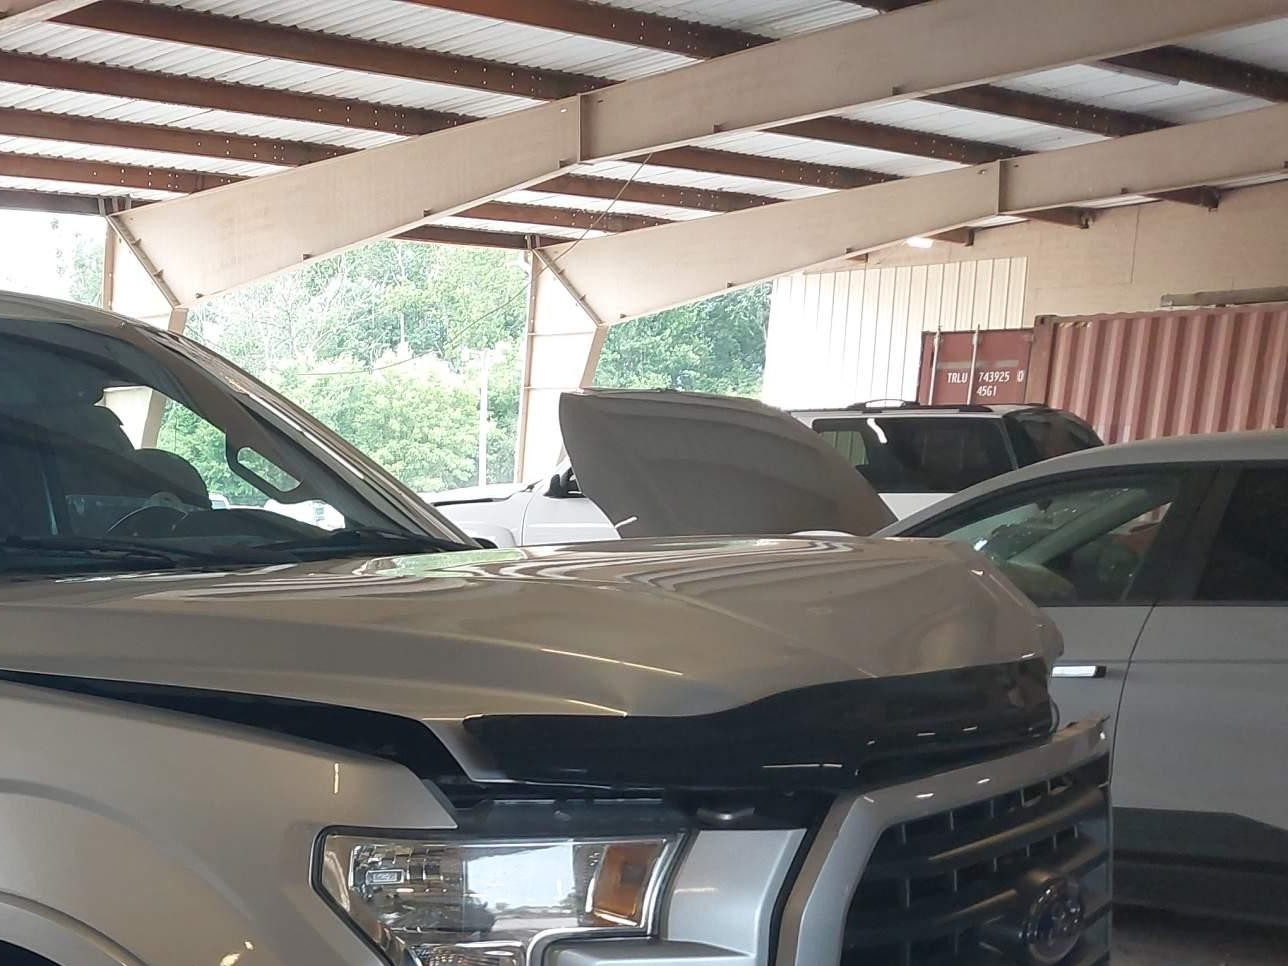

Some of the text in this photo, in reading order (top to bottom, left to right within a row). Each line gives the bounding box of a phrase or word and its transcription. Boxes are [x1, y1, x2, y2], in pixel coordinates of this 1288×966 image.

[947, 371, 968, 384] TRLU
[978, 370, 1011, 383] 743925
[976, 384, 997, 397] 45G1
